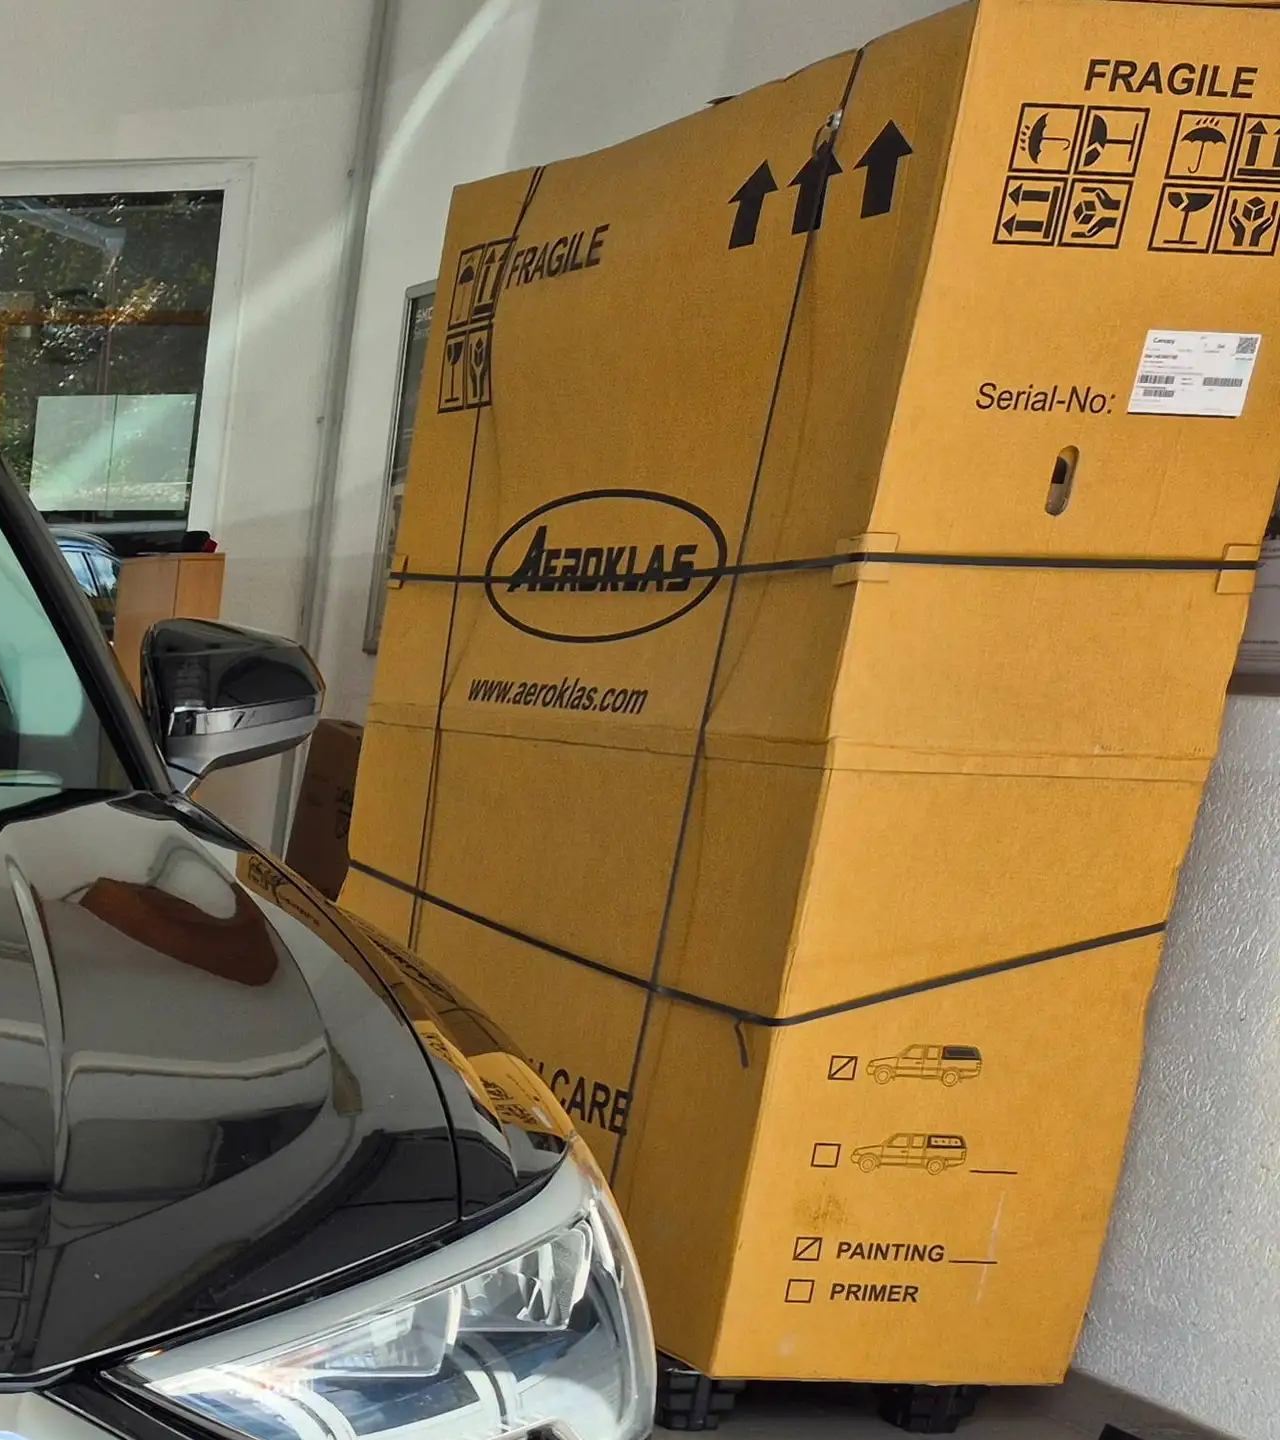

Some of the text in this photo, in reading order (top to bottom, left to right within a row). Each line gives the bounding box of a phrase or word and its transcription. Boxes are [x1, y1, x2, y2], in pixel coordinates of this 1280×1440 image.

[1083, 58, 1259, 99] FRAGILE
[504, 223, 611, 289] FRAGILE
[975, 382, 1116, 414] Serial-No:
[507, 525, 699, 593] AEROKLAS
[467, 676, 649, 715] www.aeroklas.com
[550, 1068, 633, 1136] CARE
[836, 1241, 945, 1263] PAINTING
[829, 1282, 920, 1303] PRIMER
